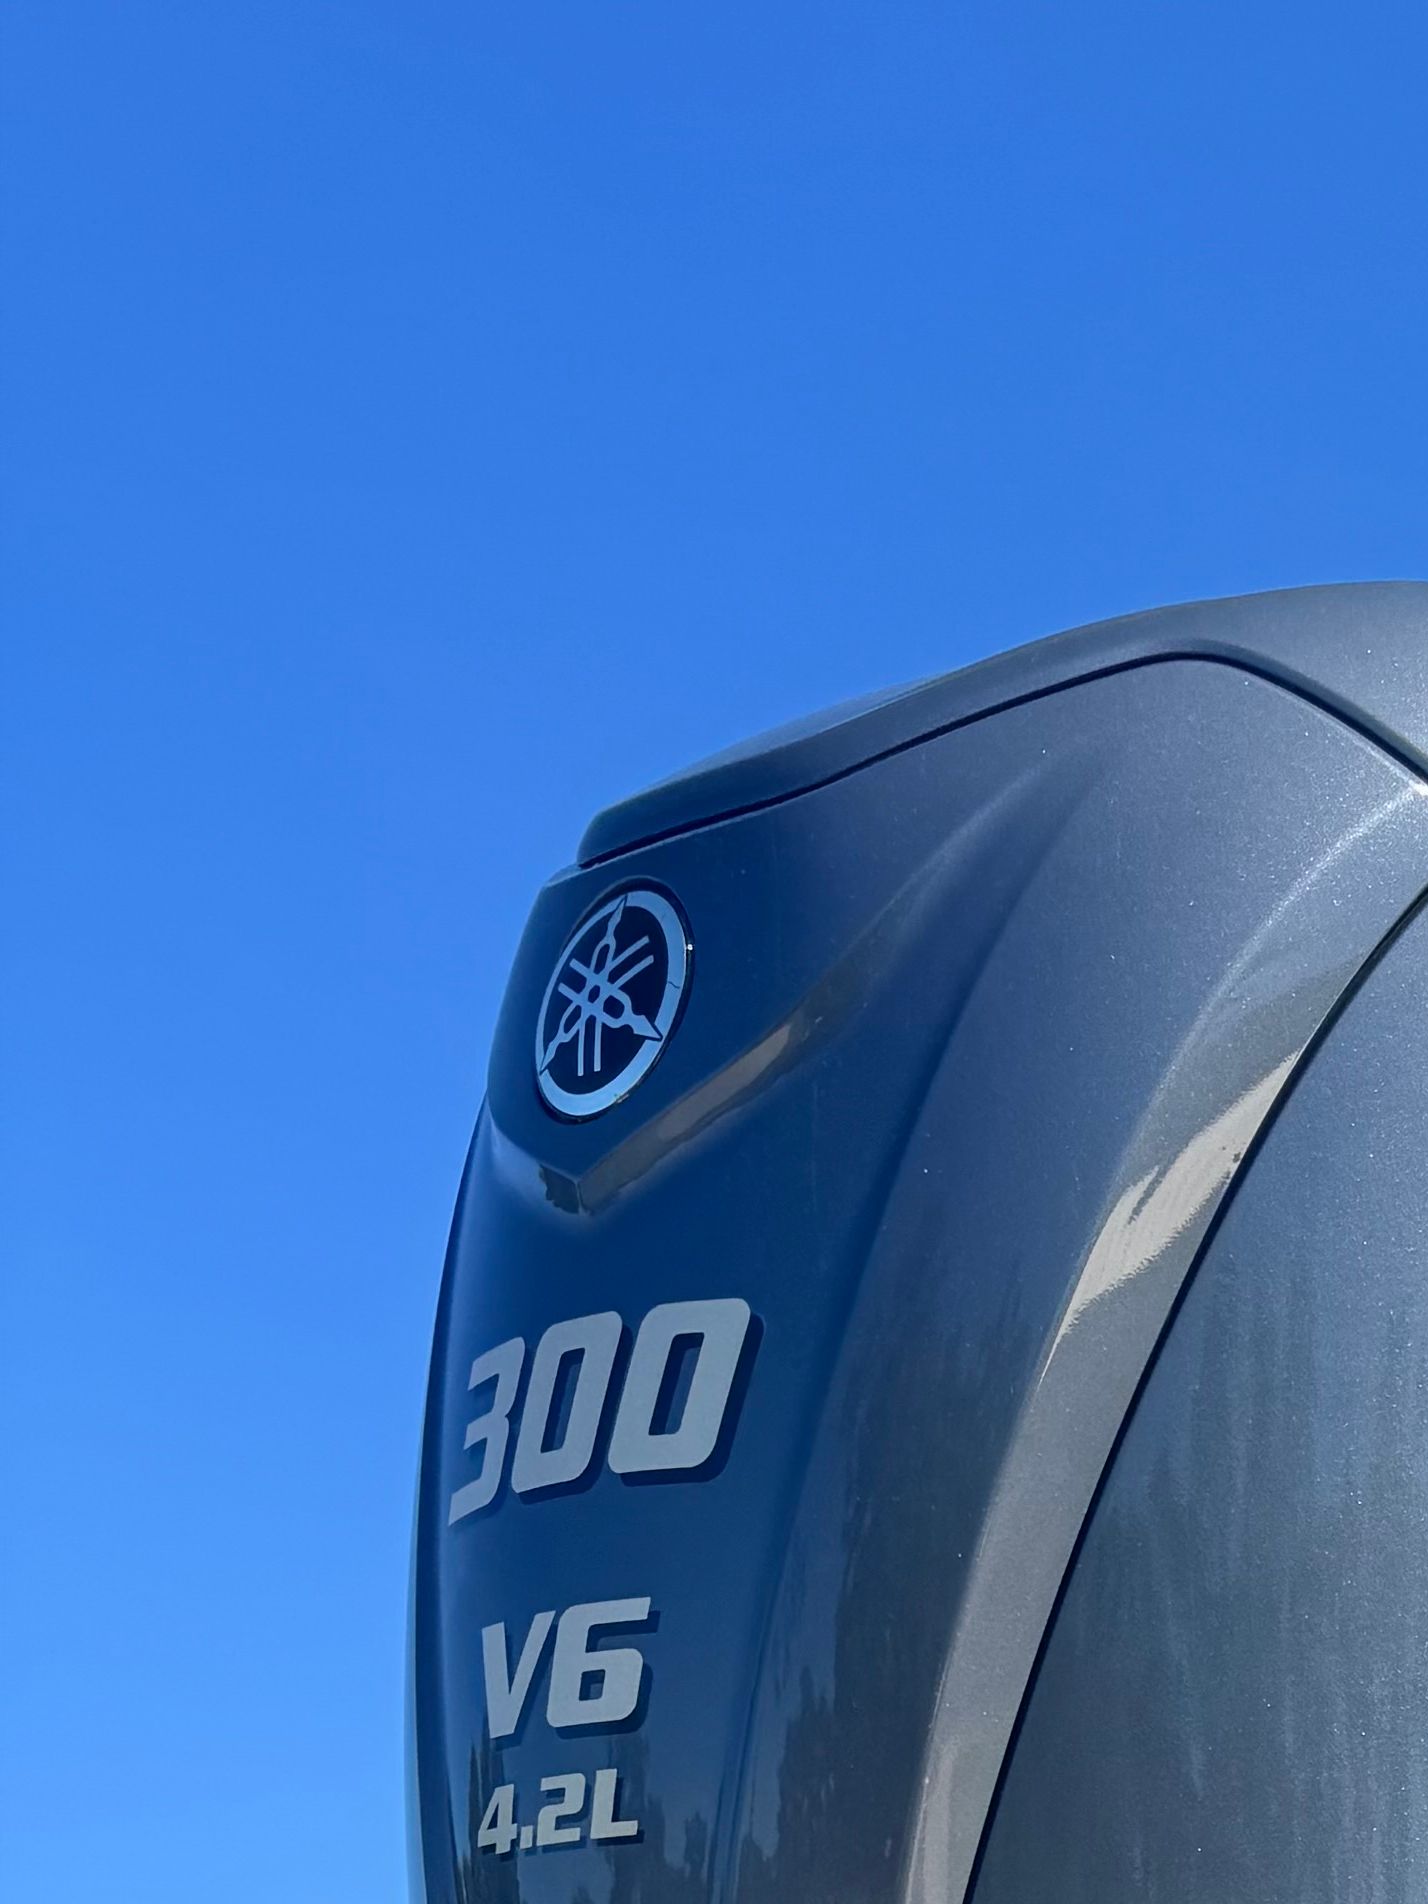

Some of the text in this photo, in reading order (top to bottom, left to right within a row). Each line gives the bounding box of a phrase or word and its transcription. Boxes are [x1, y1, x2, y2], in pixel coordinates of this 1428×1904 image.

[448, 1298, 752, 1525] 300
[481, 1597, 652, 1738] V6
[477, 1769, 640, 1854] 4.2L
